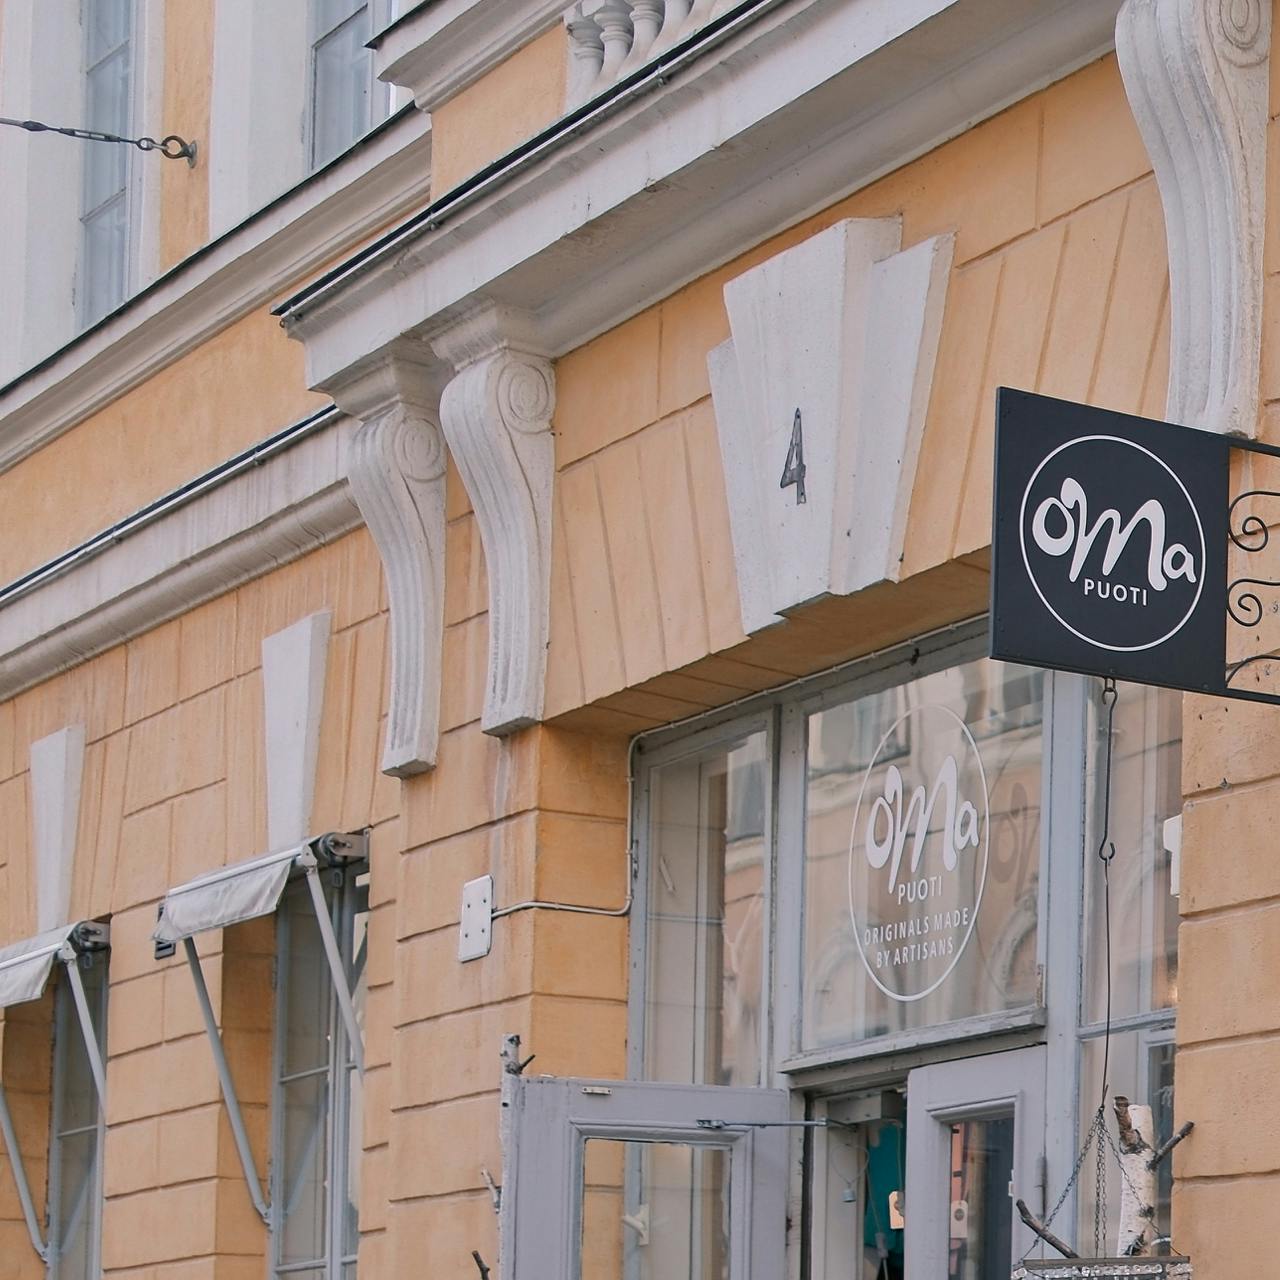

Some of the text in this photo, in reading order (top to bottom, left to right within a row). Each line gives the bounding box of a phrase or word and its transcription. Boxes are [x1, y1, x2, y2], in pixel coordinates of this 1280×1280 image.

[780, 408, 806, 505] 4
[1084, 578, 1148, 606] PUOTI
[898, 876, 942, 905] PUOTI
[864, 907, 969, 945] ORIGINALS MADE
[877, 936, 953, 968] BY ARTISANS
